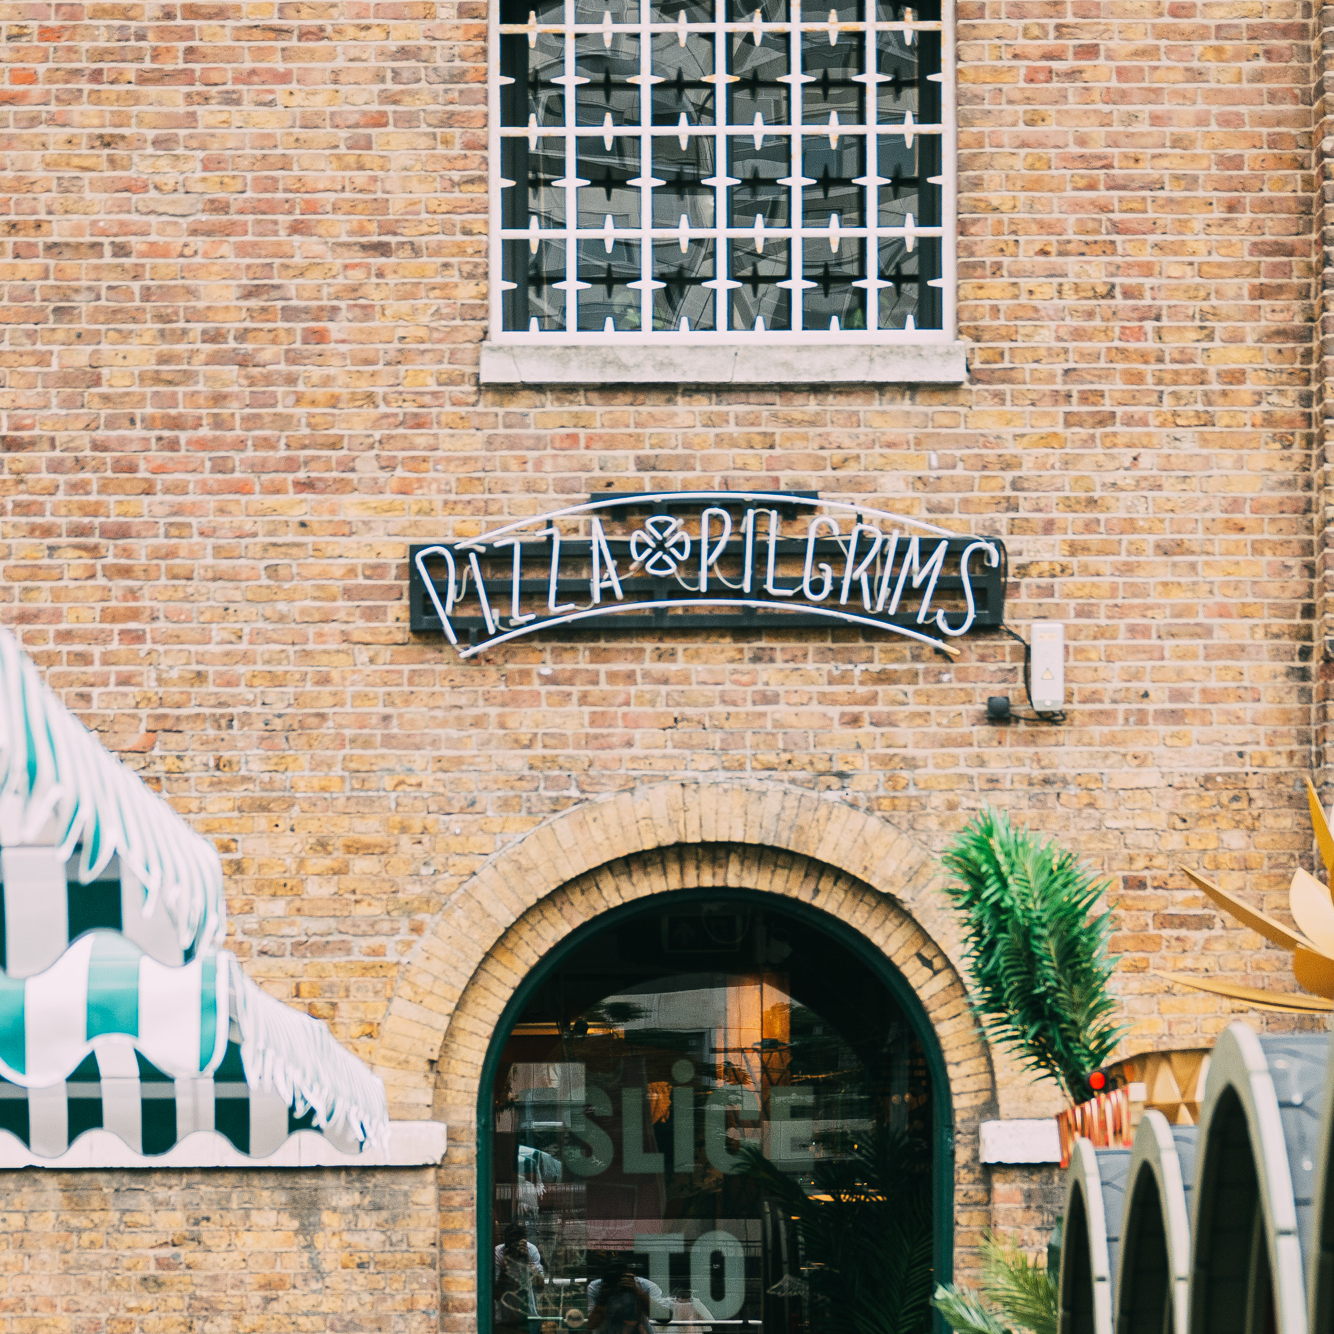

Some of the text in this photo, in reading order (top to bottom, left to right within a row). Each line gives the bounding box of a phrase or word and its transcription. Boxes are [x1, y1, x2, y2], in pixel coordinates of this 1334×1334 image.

[414, 506, 999, 646] PIZZA PILGRIMS
[633, 1229, 747, 1321] TO
